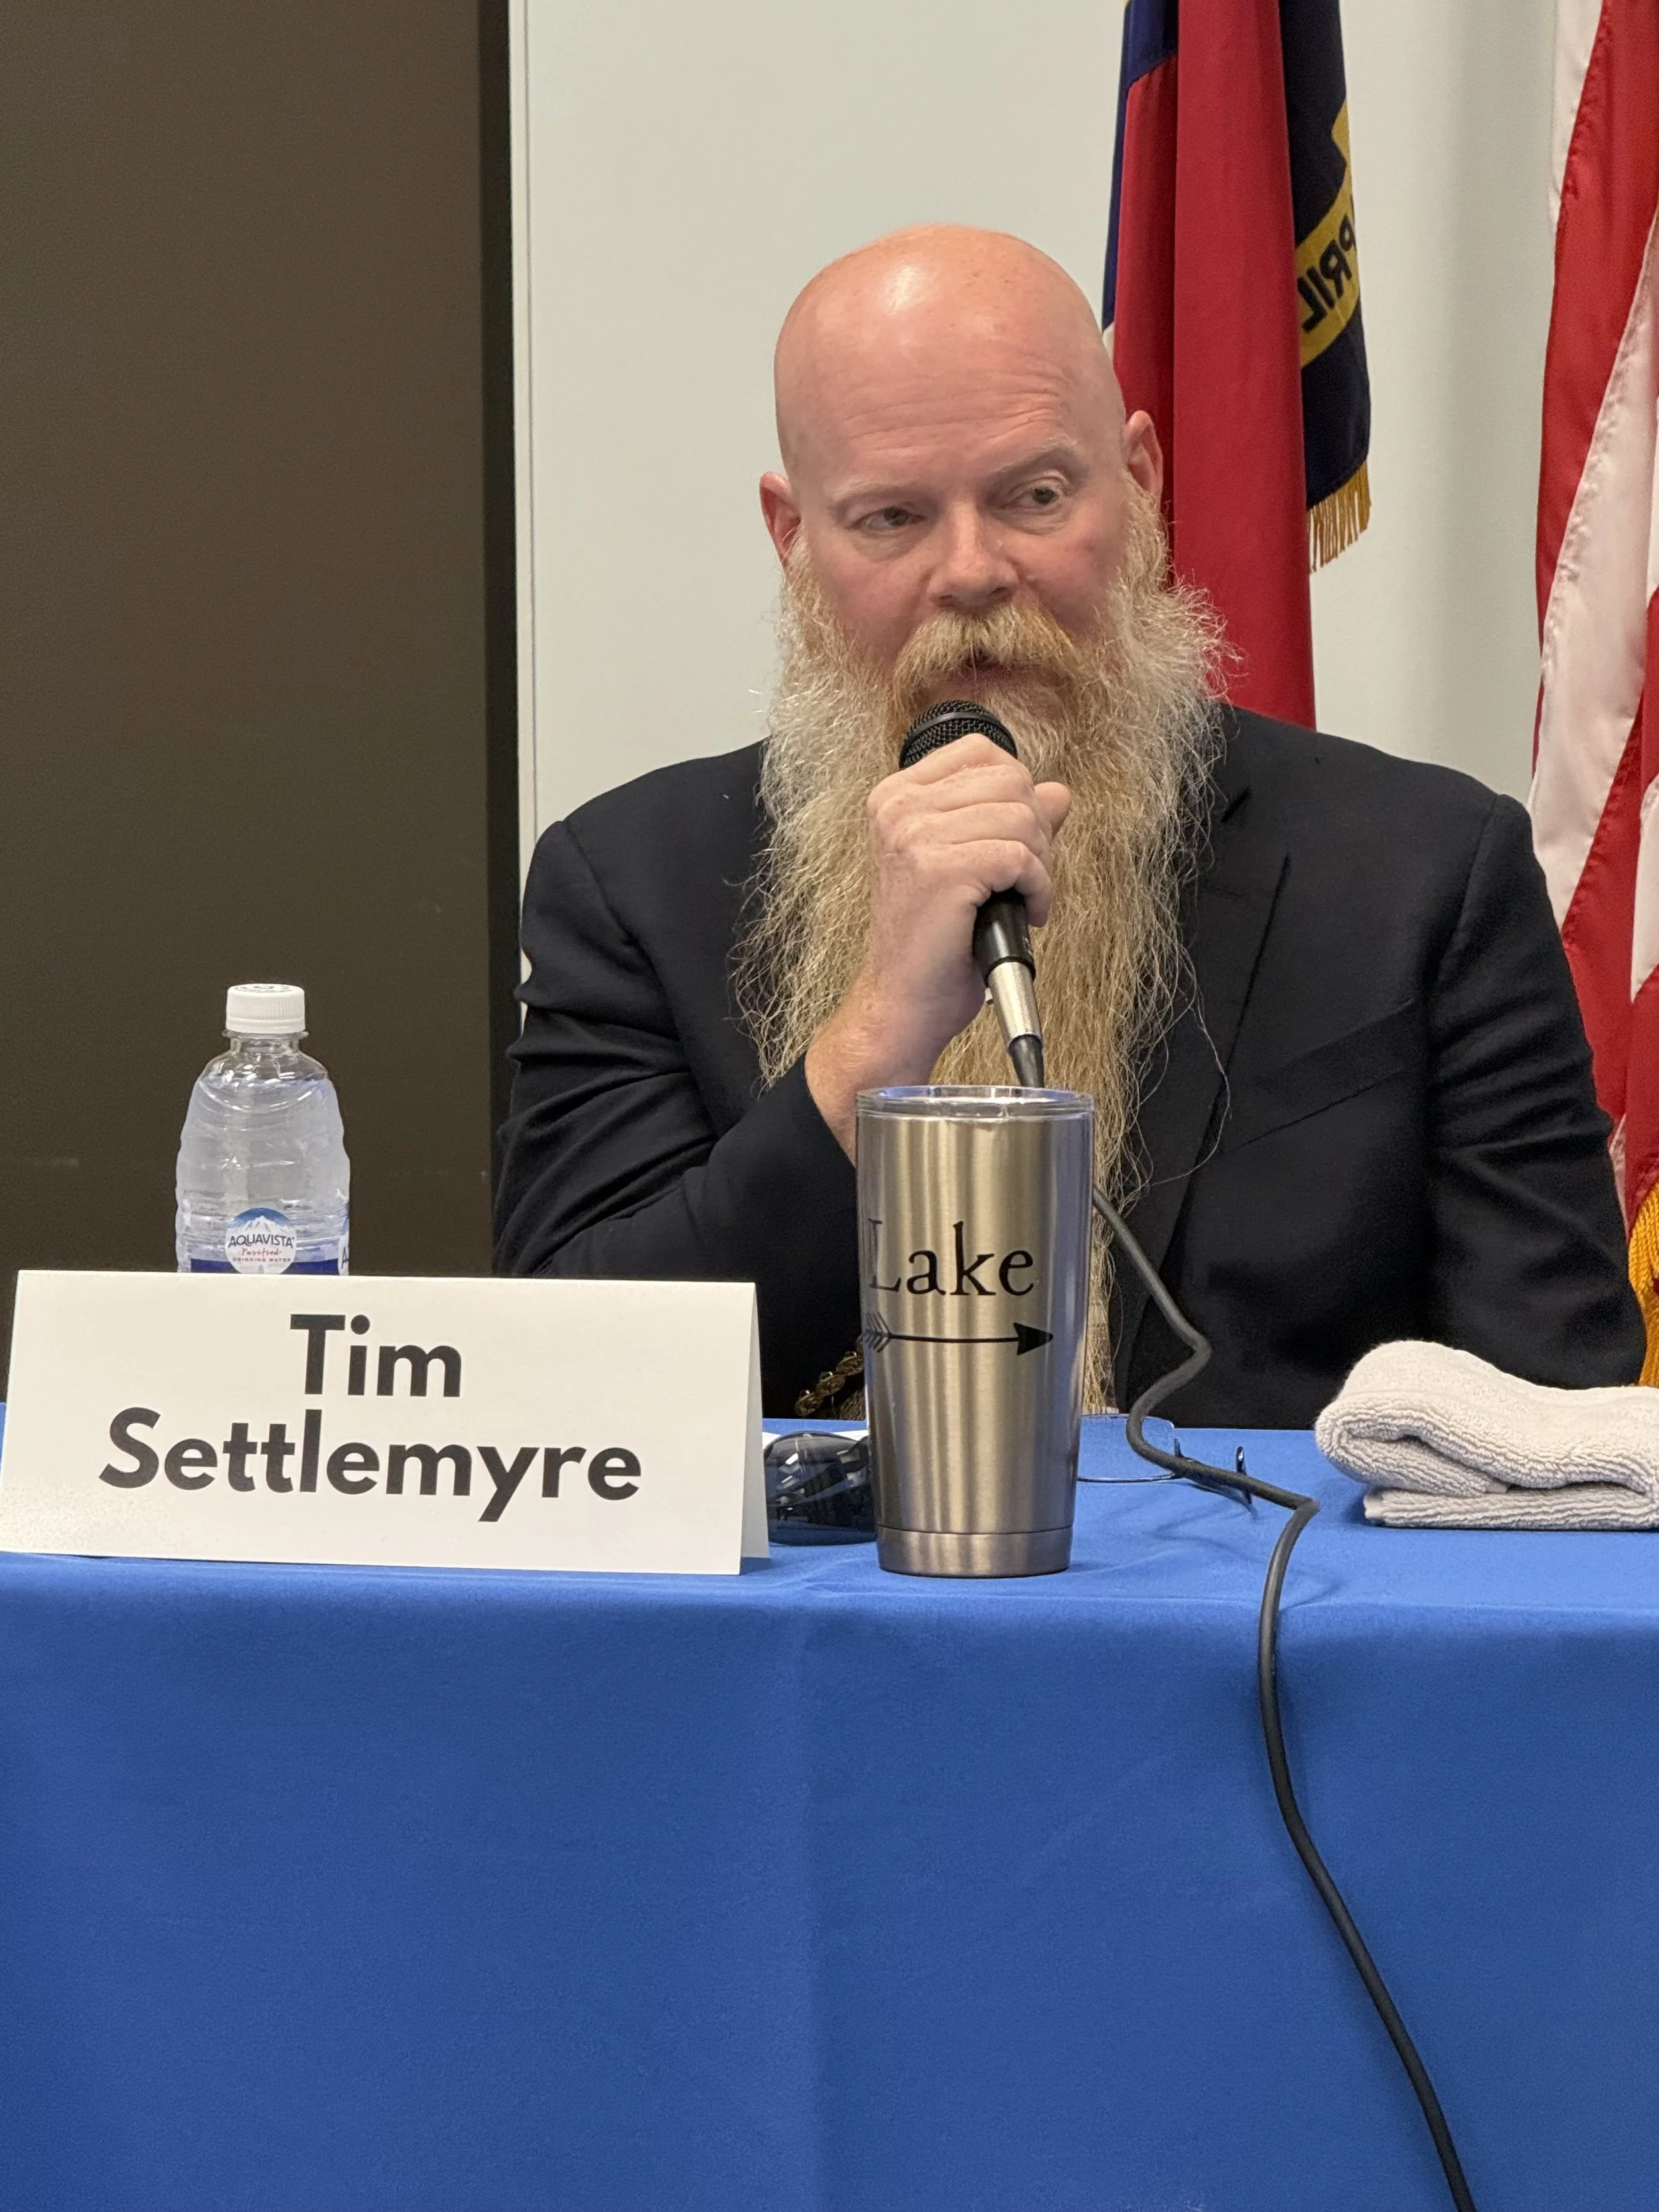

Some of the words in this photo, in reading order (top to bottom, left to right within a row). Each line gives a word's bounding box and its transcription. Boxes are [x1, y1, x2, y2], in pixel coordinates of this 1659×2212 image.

[228, 1234, 294, 1248] AQUAVISTA
[868, 1218, 1034, 1296] Lake
[290, 1313, 462, 1398] Tim
[99, 1407, 642, 1522] Settlemyre
